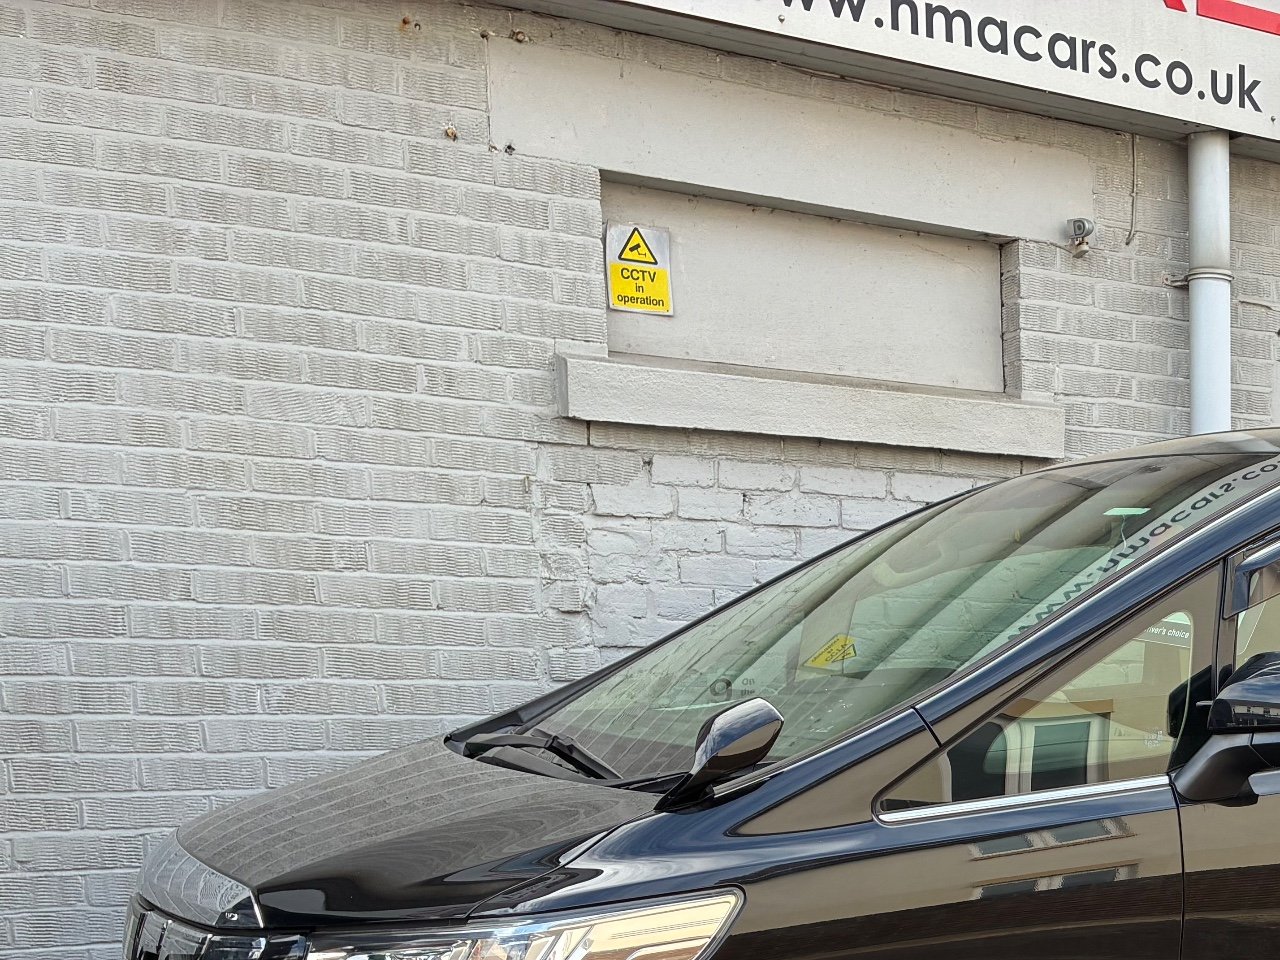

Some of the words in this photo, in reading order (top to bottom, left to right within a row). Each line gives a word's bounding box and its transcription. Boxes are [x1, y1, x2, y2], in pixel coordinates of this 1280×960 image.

[620, 267, 657, 283] CCTV
[635, 282, 645, 293] in
[617, 294, 665, 307] operation
[1167, 629, 1190, 639] choice
